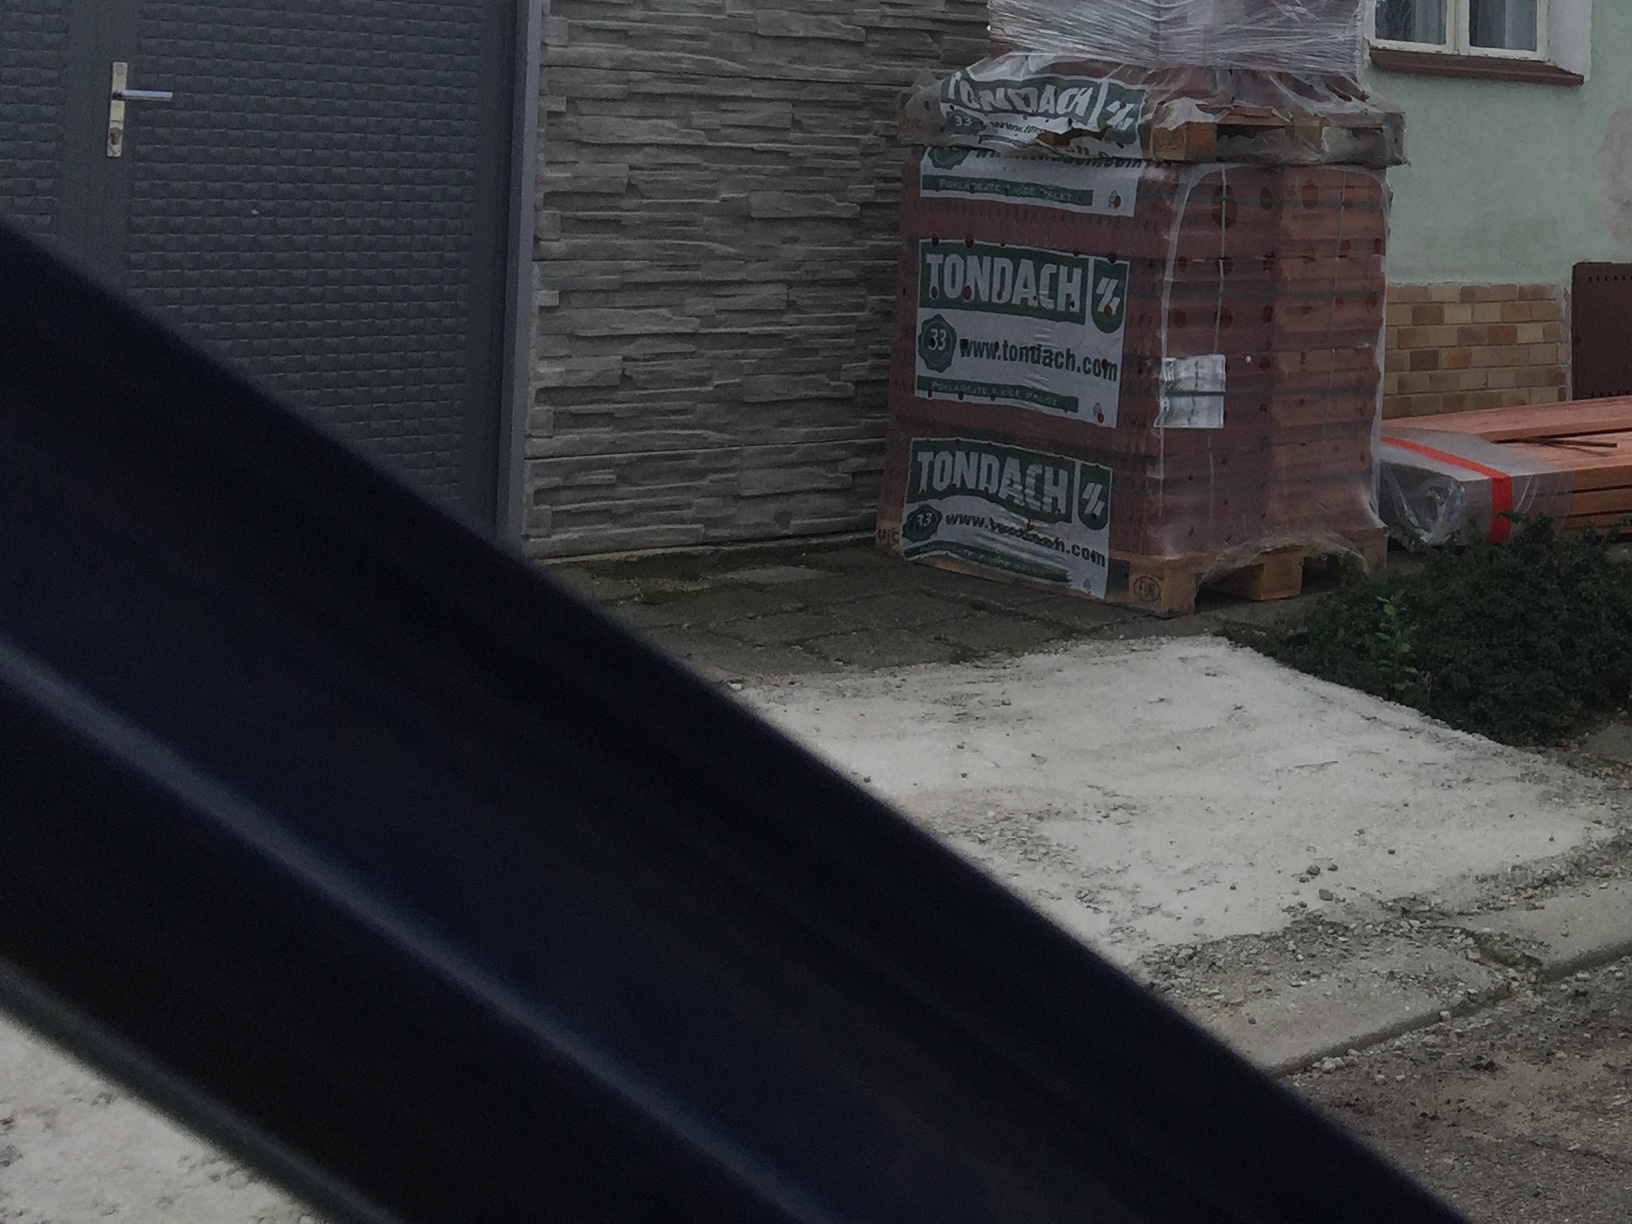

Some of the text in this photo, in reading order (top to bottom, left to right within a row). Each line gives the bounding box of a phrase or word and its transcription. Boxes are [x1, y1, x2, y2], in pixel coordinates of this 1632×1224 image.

[949, 72, 1092, 117] TONDACH
[955, 115, 972, 127] 33
[926, 253, 1083, 313] TONDACH
[928, 328, 947, 352] 33
[960, 338, 1118, 382] www.tondach.com
[917, 451, 1068, 515] TONDACH
[916, 513, 932, 527] 33
